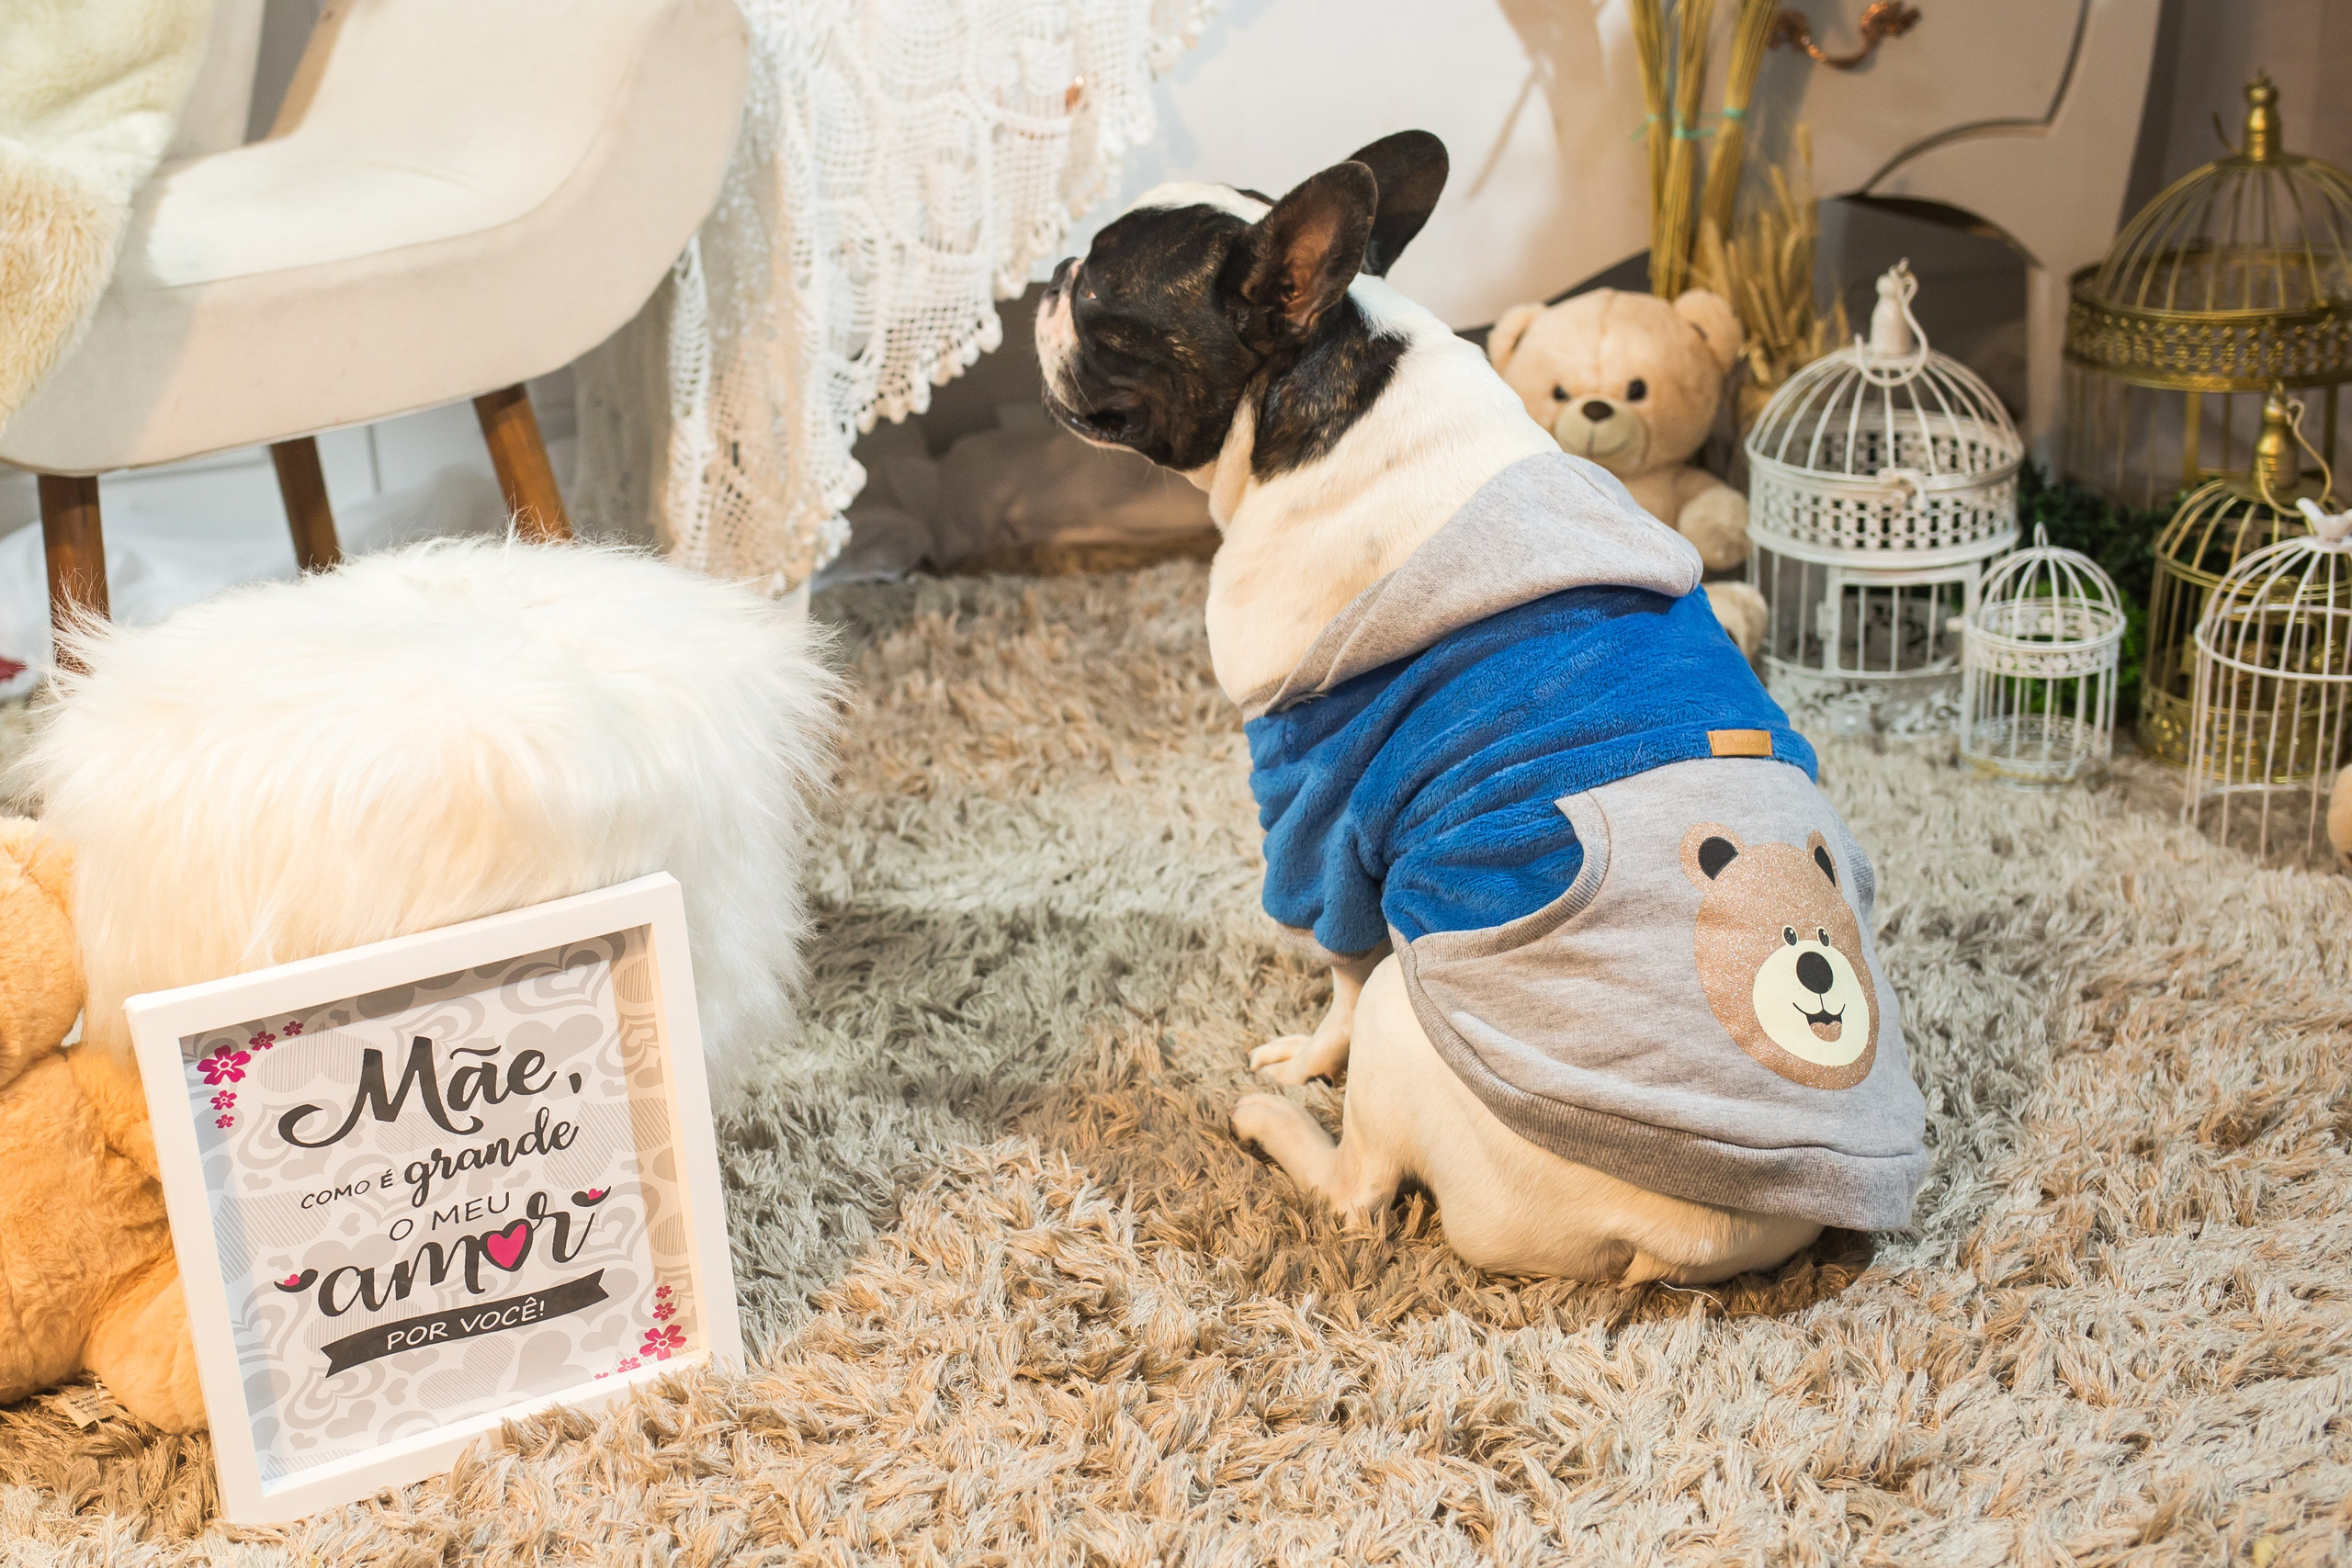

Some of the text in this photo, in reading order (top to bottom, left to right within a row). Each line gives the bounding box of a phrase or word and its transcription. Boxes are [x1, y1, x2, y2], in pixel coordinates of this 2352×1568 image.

[277, 1035, 582, 1148] Mãe,
[300, 1106, 579, 1210] COMO É grande
[317, 1190, 595, 1317] amor
[389, 1190, 510, 1241] O MEU
[386, 1296, 545, 1350] POR VOCÊ!
